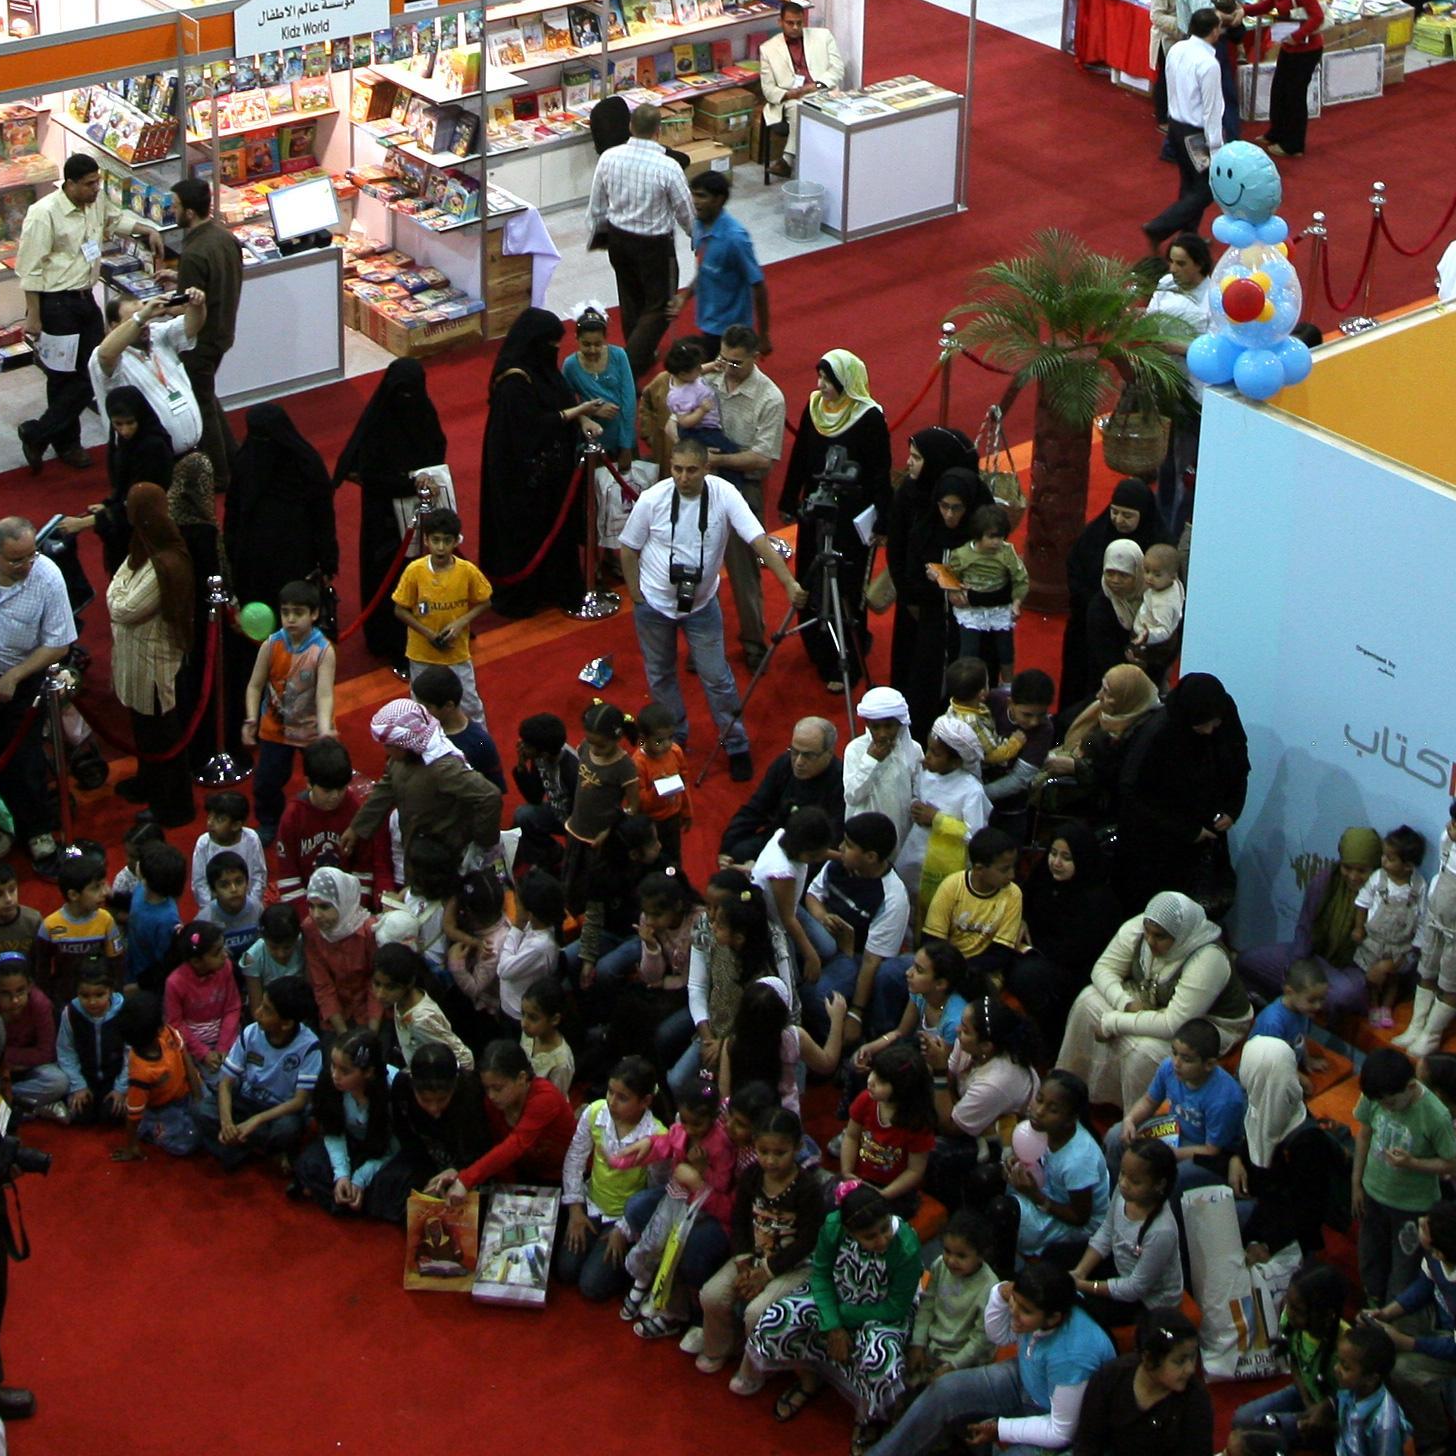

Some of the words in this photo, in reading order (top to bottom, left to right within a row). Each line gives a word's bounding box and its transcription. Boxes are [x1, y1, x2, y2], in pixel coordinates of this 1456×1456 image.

[297, 1, 319, 19] عالم
[281, 24, 301, 41] Kidz
[302, 19, 330, 38] World
[1344, 722, 1451, 790] كتاب
[300, 831, 325, 857] MAJOR
